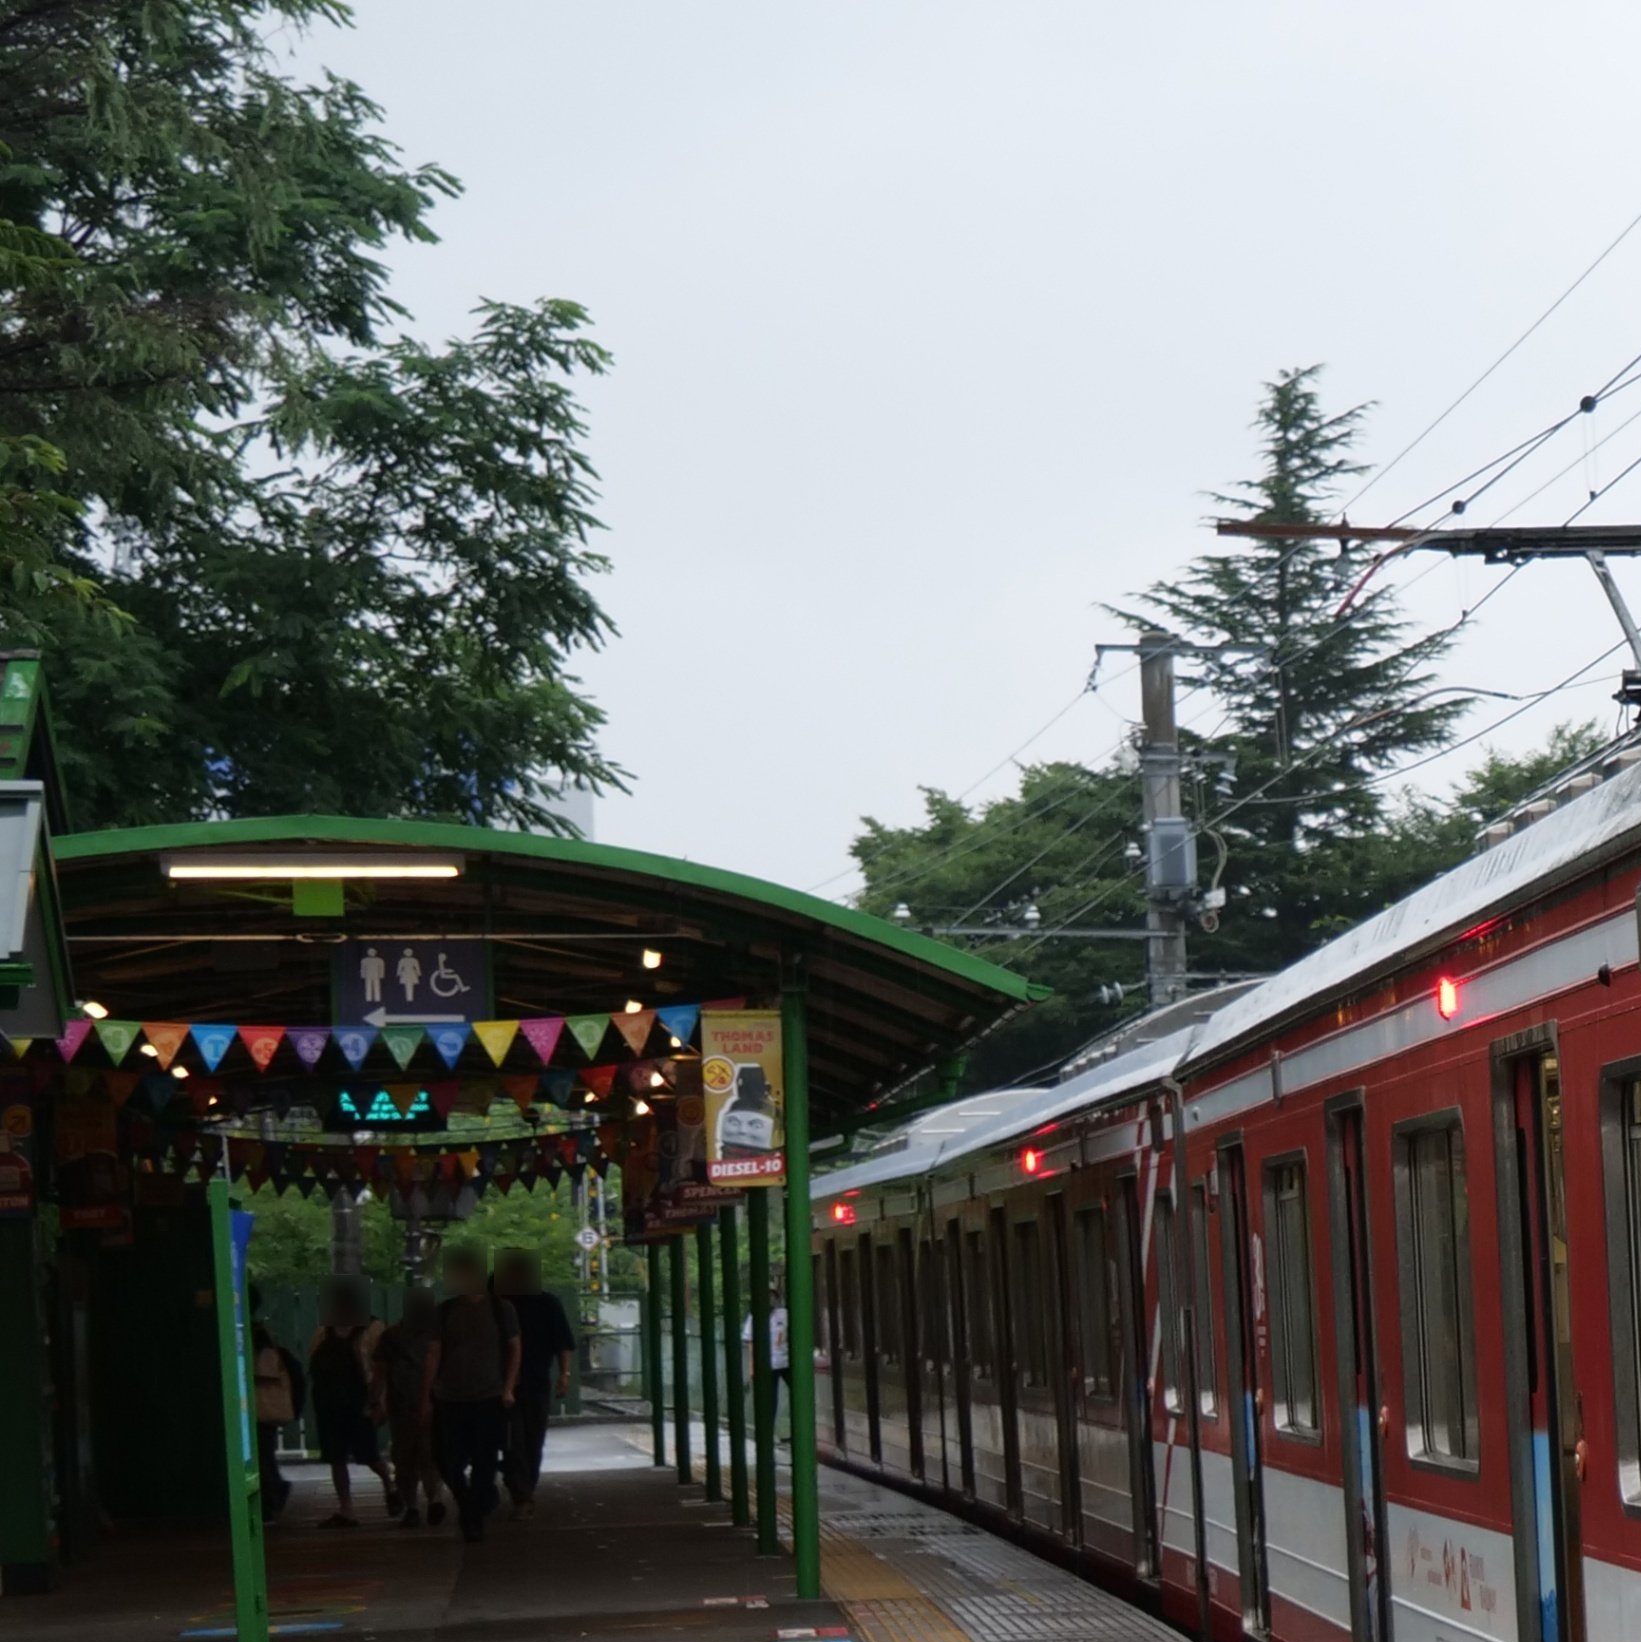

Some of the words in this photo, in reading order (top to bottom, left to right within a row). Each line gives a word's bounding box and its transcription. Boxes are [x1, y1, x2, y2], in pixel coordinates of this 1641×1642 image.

[711, 1030, 774, 1041] THOMAS
[722, 1042, 764, 1054] LAND
[711, 1158, 782, 1177] DIESEL-10
